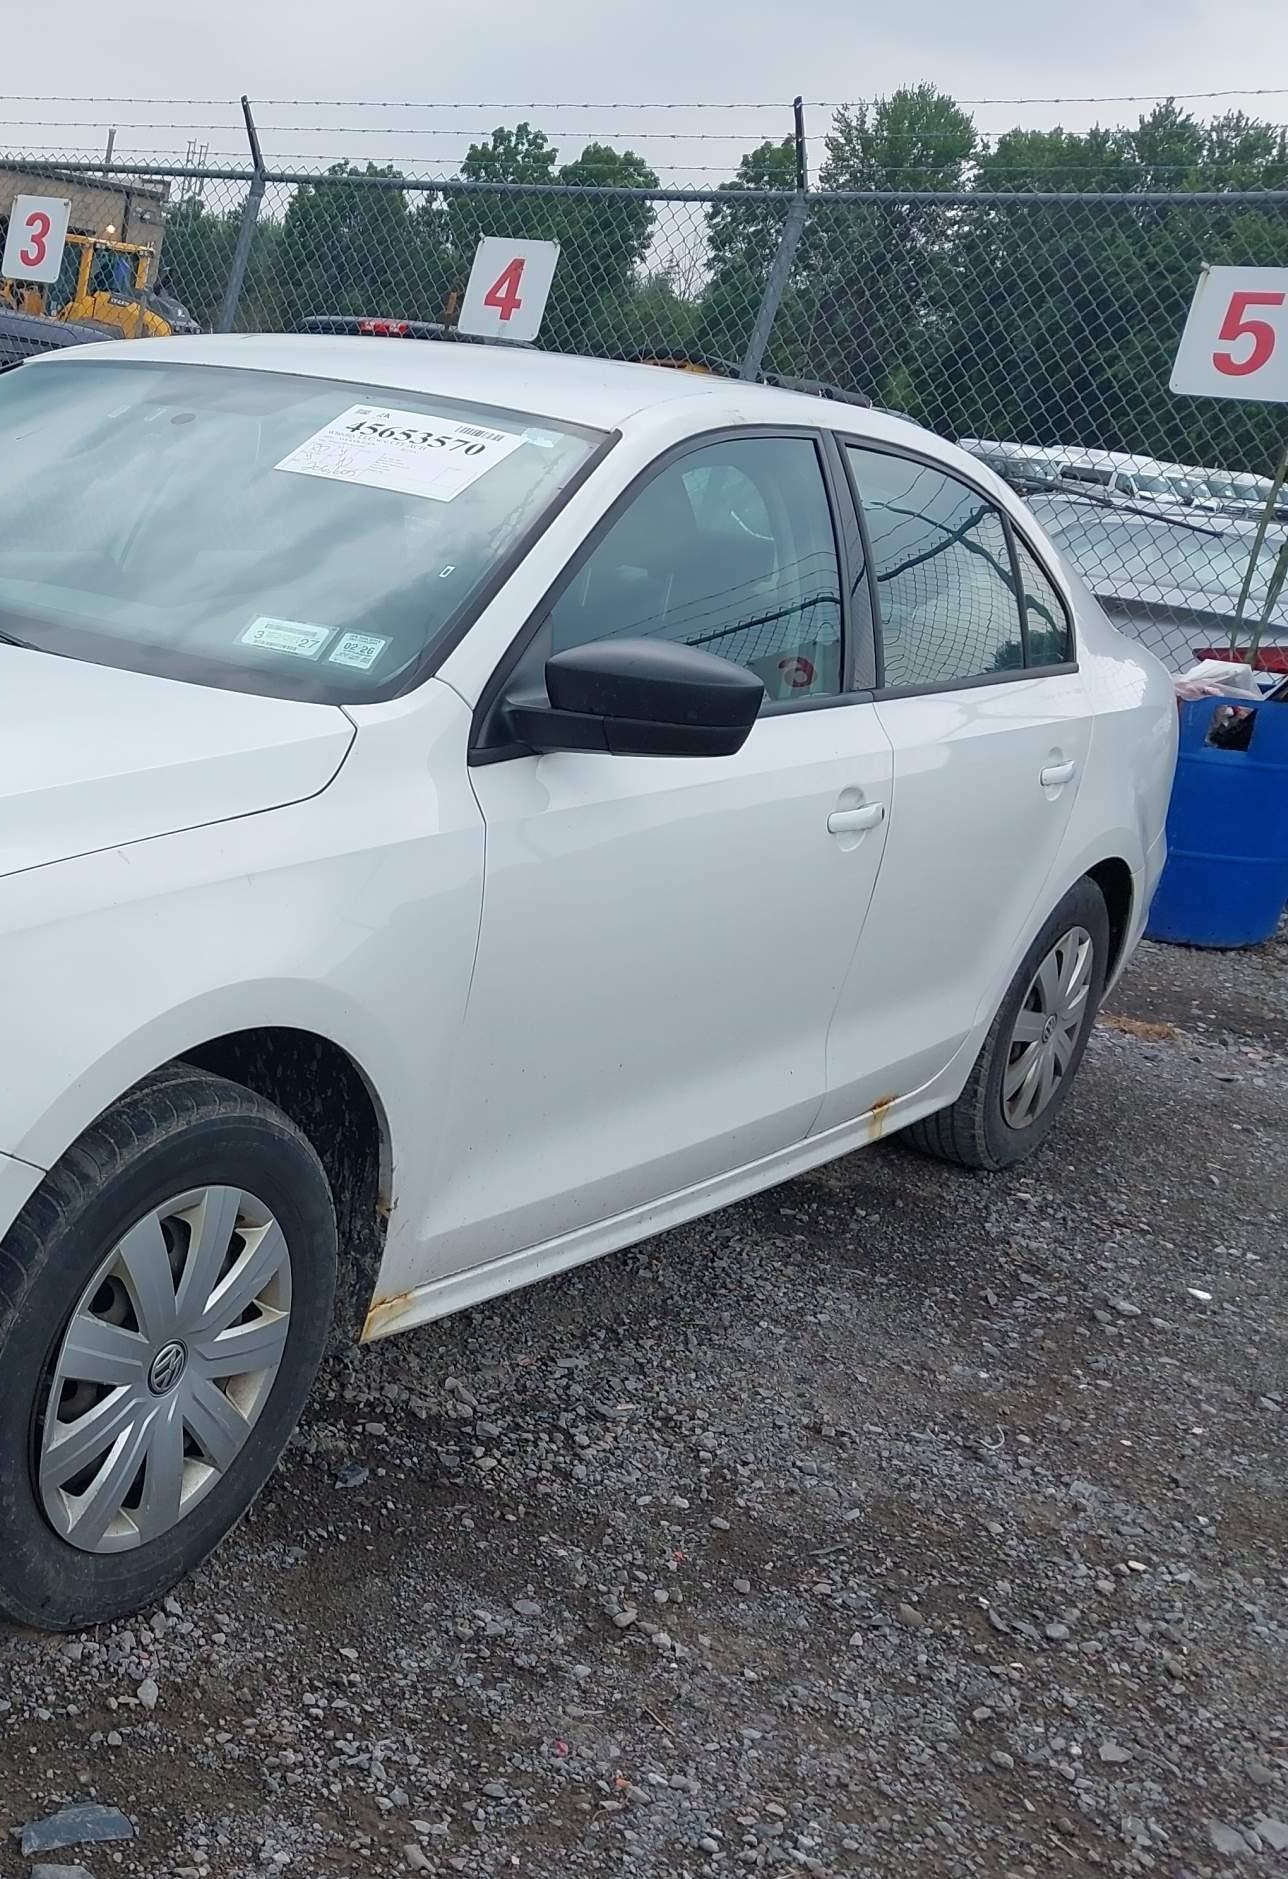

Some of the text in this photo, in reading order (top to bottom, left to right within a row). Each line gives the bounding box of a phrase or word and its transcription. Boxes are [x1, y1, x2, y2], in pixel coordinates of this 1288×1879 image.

[20, 211, 51, 267] 3
[483, 258, 526, 321] 4
[1212, 291, 1286, 376] 5
[345, 420, 486, 457] 45653570
